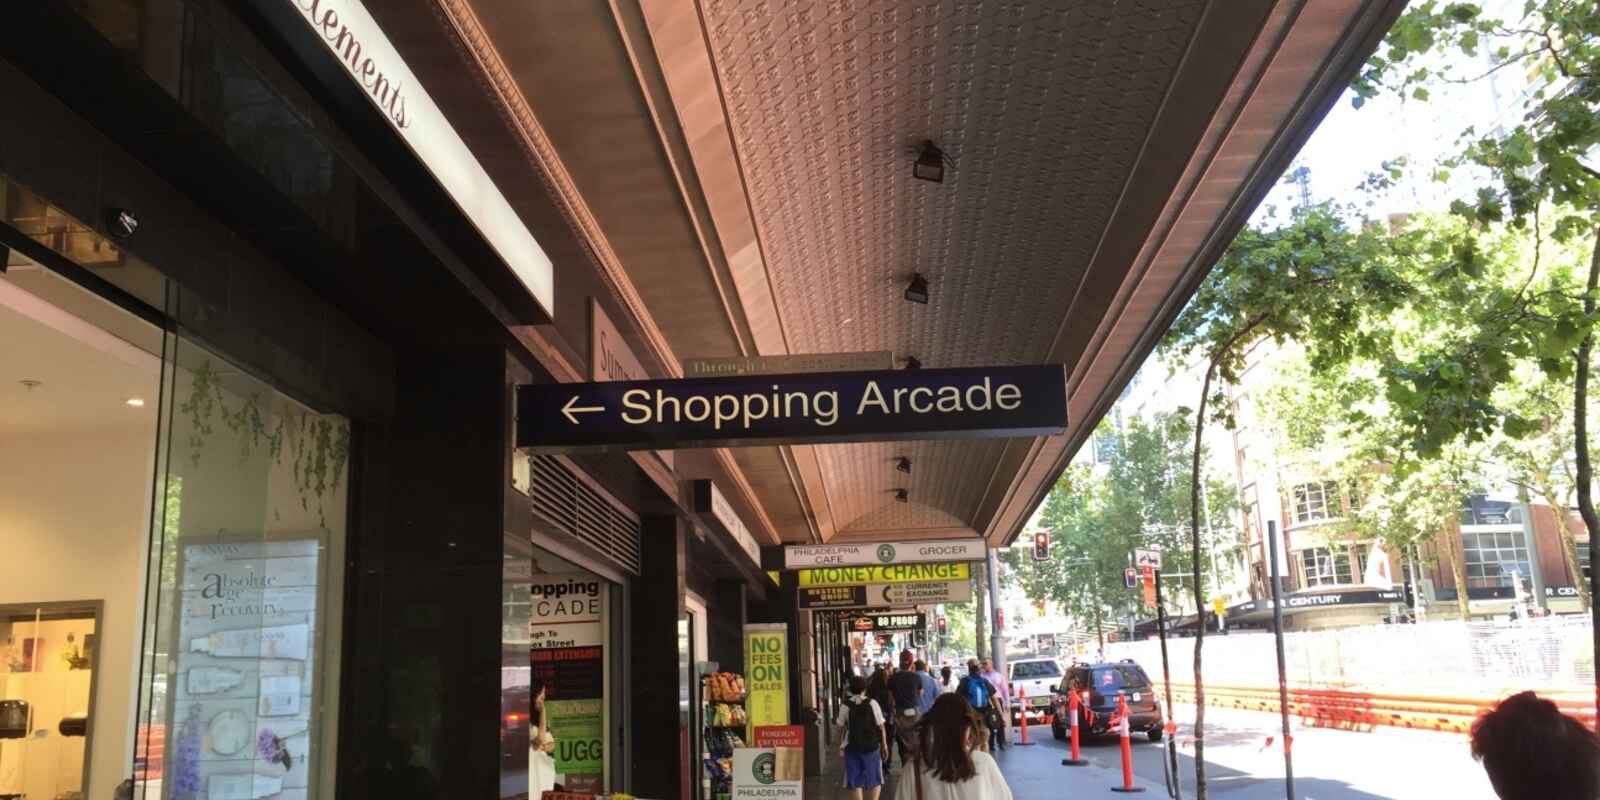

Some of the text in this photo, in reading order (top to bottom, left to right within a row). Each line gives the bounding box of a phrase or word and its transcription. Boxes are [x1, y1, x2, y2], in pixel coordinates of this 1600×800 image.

[620, 376, 1022, 429] Shopping Arcade
[793, 546, 860, 556] PHILADELPHIA
[919, 545, 967, 555] GROCER
[815, 555, 844, 564] CAFE
[809, 562, 958, 584] MONEY CHANGE
[906, 589, 949, 597] EXCHANGE
[1289, 594, 1342, 606] CENTURY
[529, 599, 600, 616] CADE
[890, 615, 918, 626] PROOF
[546, 640, 575, 648] Street
[751, 637, 781, 653] NO
[752, 654, 782, 664] FEES
[752, 665, 782, 682] ON
[753, 682, 782, 690] SALES
[560, 740, 602, 762] UGG
[737, 789, 797, 797] PHILADELPHIA
